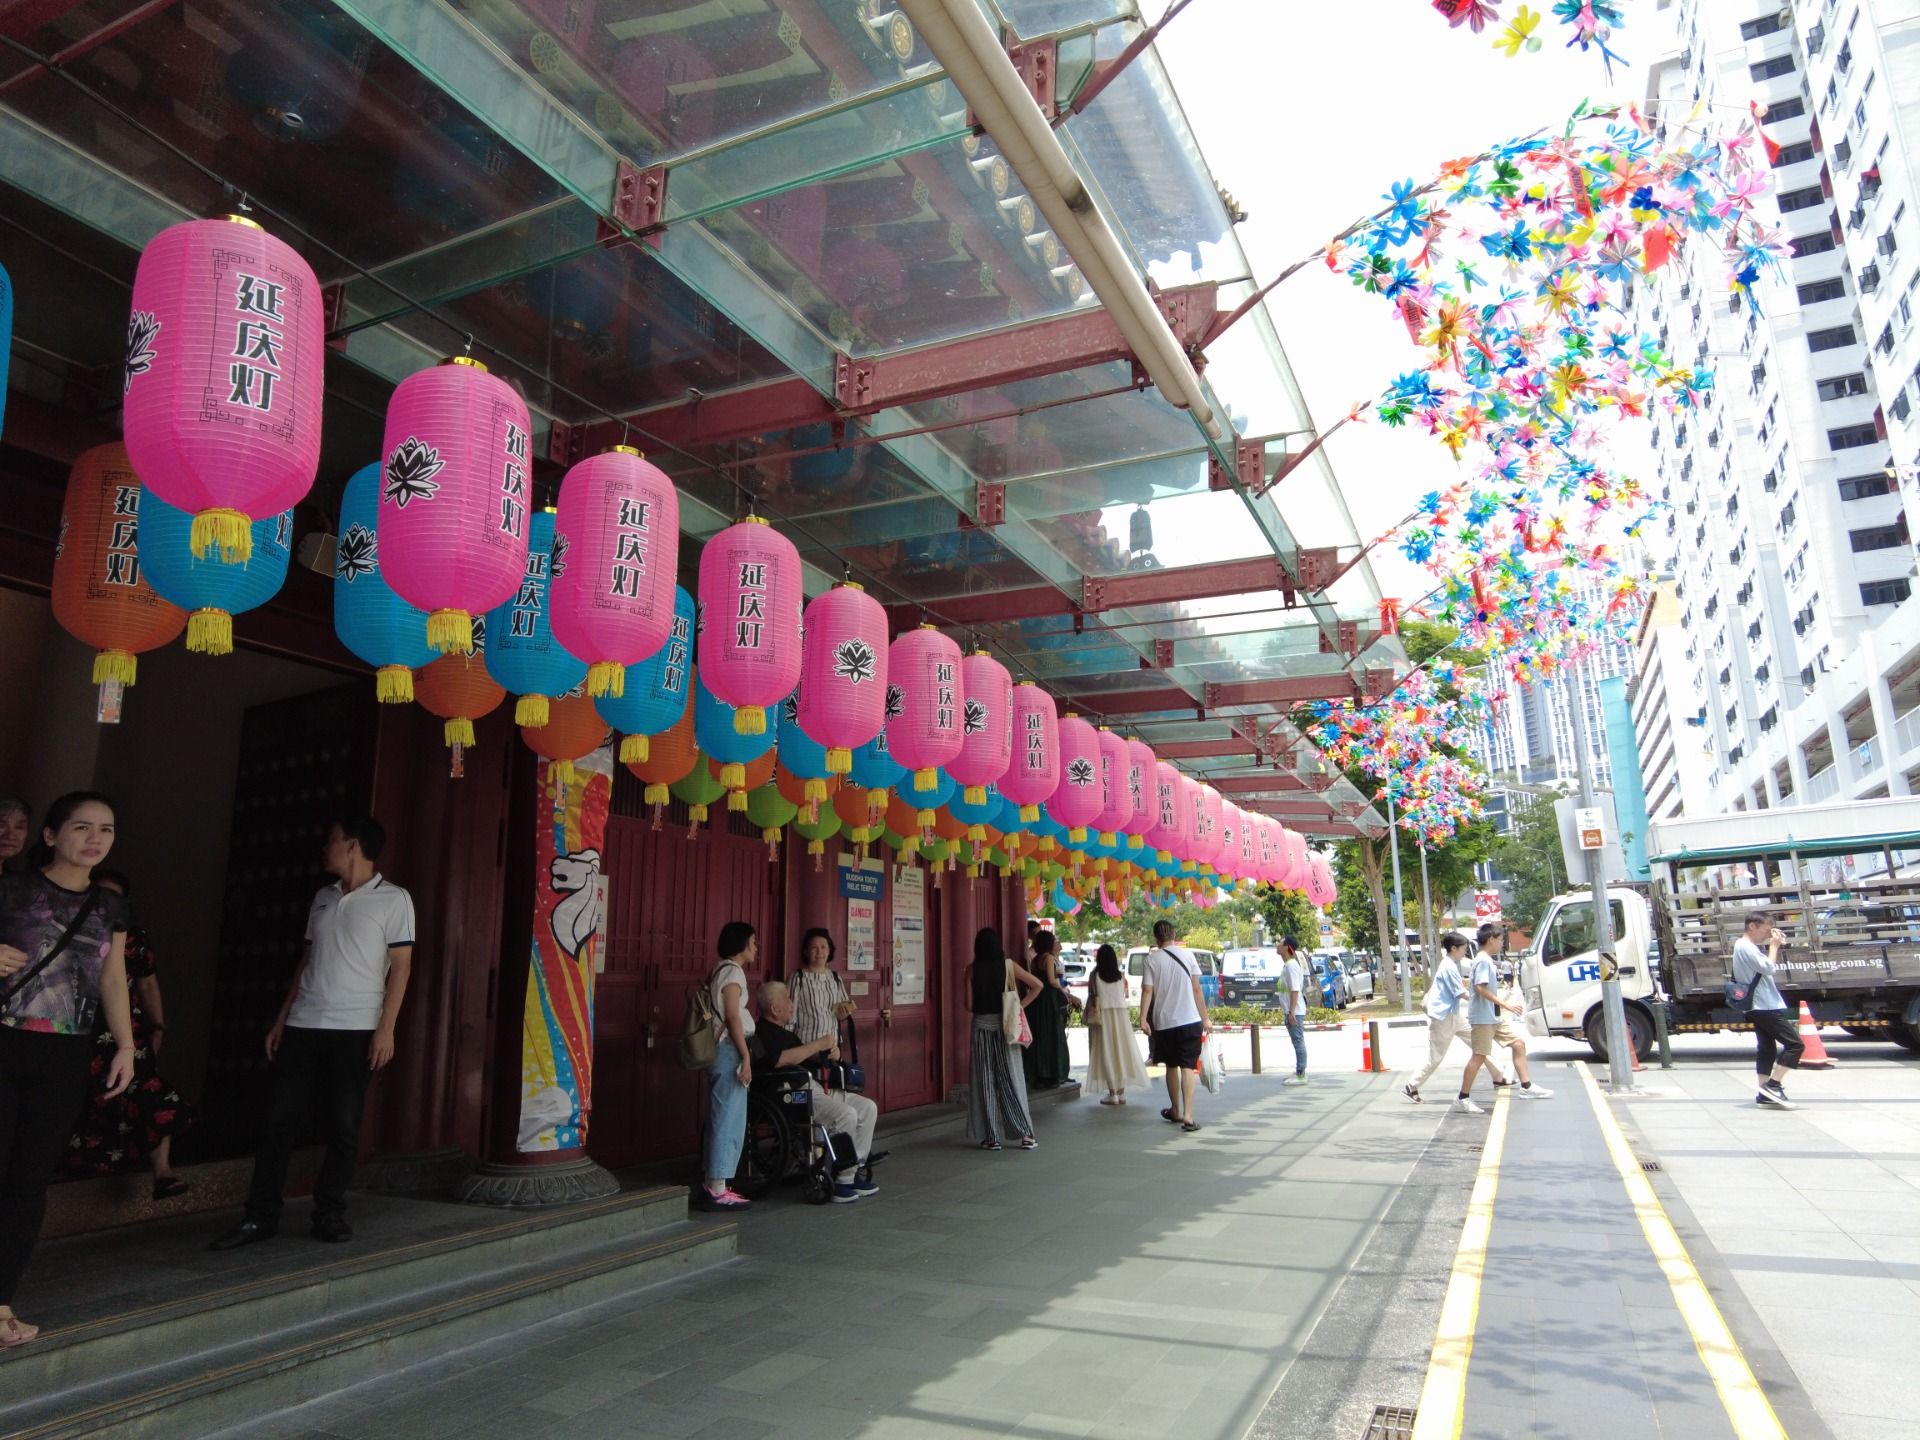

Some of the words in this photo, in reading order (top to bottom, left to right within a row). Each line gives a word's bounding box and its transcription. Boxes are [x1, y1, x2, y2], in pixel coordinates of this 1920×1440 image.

[227, 272, 284, 412] 延庆灯
[500, 420, 529, 540] 延庆灯
[104, 486, 139, 586] 延庆灯
[610, 497, 649, 599] 延庆灯
[735, 562, 767, 649] 延庆灯
[661, 615, 689, 693] 延庆灯
[936, 663, 954, 730] 延庆灯
[1025, 713, 1044, 770] 延庆灯
[1160, 784, 1173, 825] 延庆灯
[851, 907, 872, 918] DANGER
